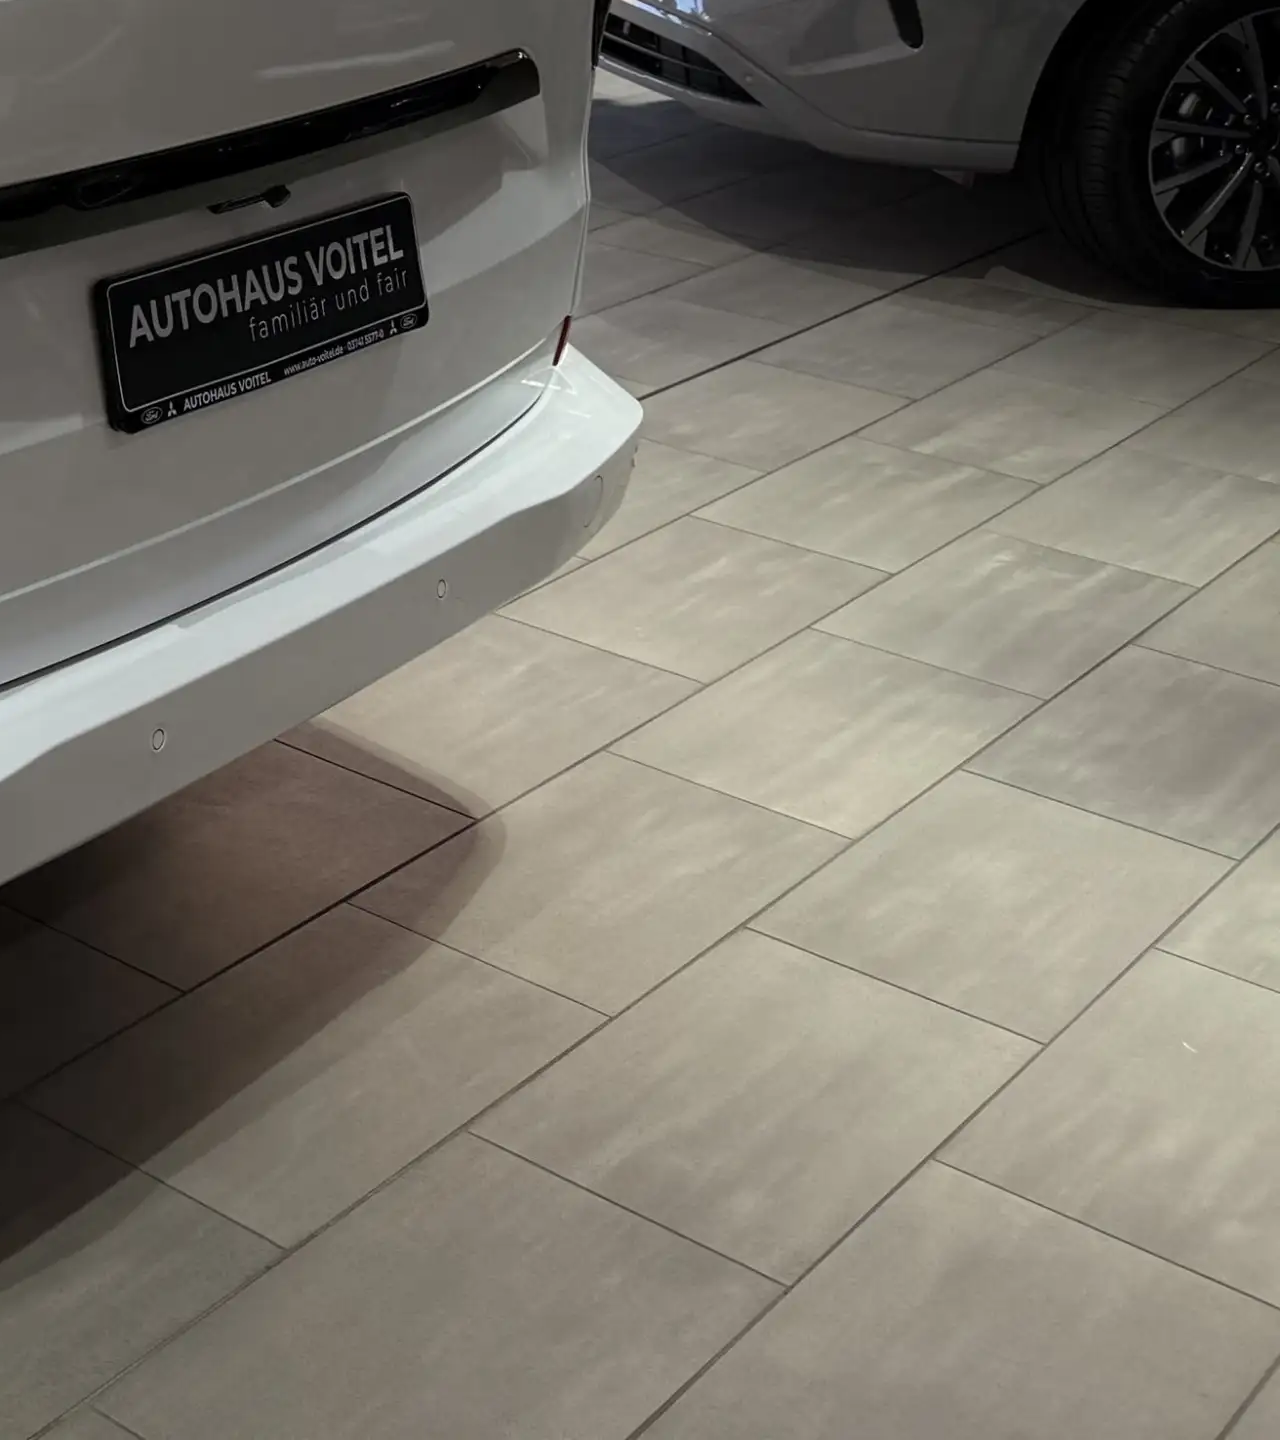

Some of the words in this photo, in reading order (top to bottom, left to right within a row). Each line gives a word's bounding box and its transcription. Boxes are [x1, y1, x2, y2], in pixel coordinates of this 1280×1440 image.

[129, 256, 302, 348] AUTOHAUS
[305, 224, 404, 287] VOITEL
[249, 296, 327, 342] familiär
[335, 277, 370, 311] und
[377, 267, 408, 298] fair
[183, 382, 238, 411] AUTOHAUS
[238, 371, 272, 392] VOITEL
[284, 345, 344, 376] www.auto-voitel.de
